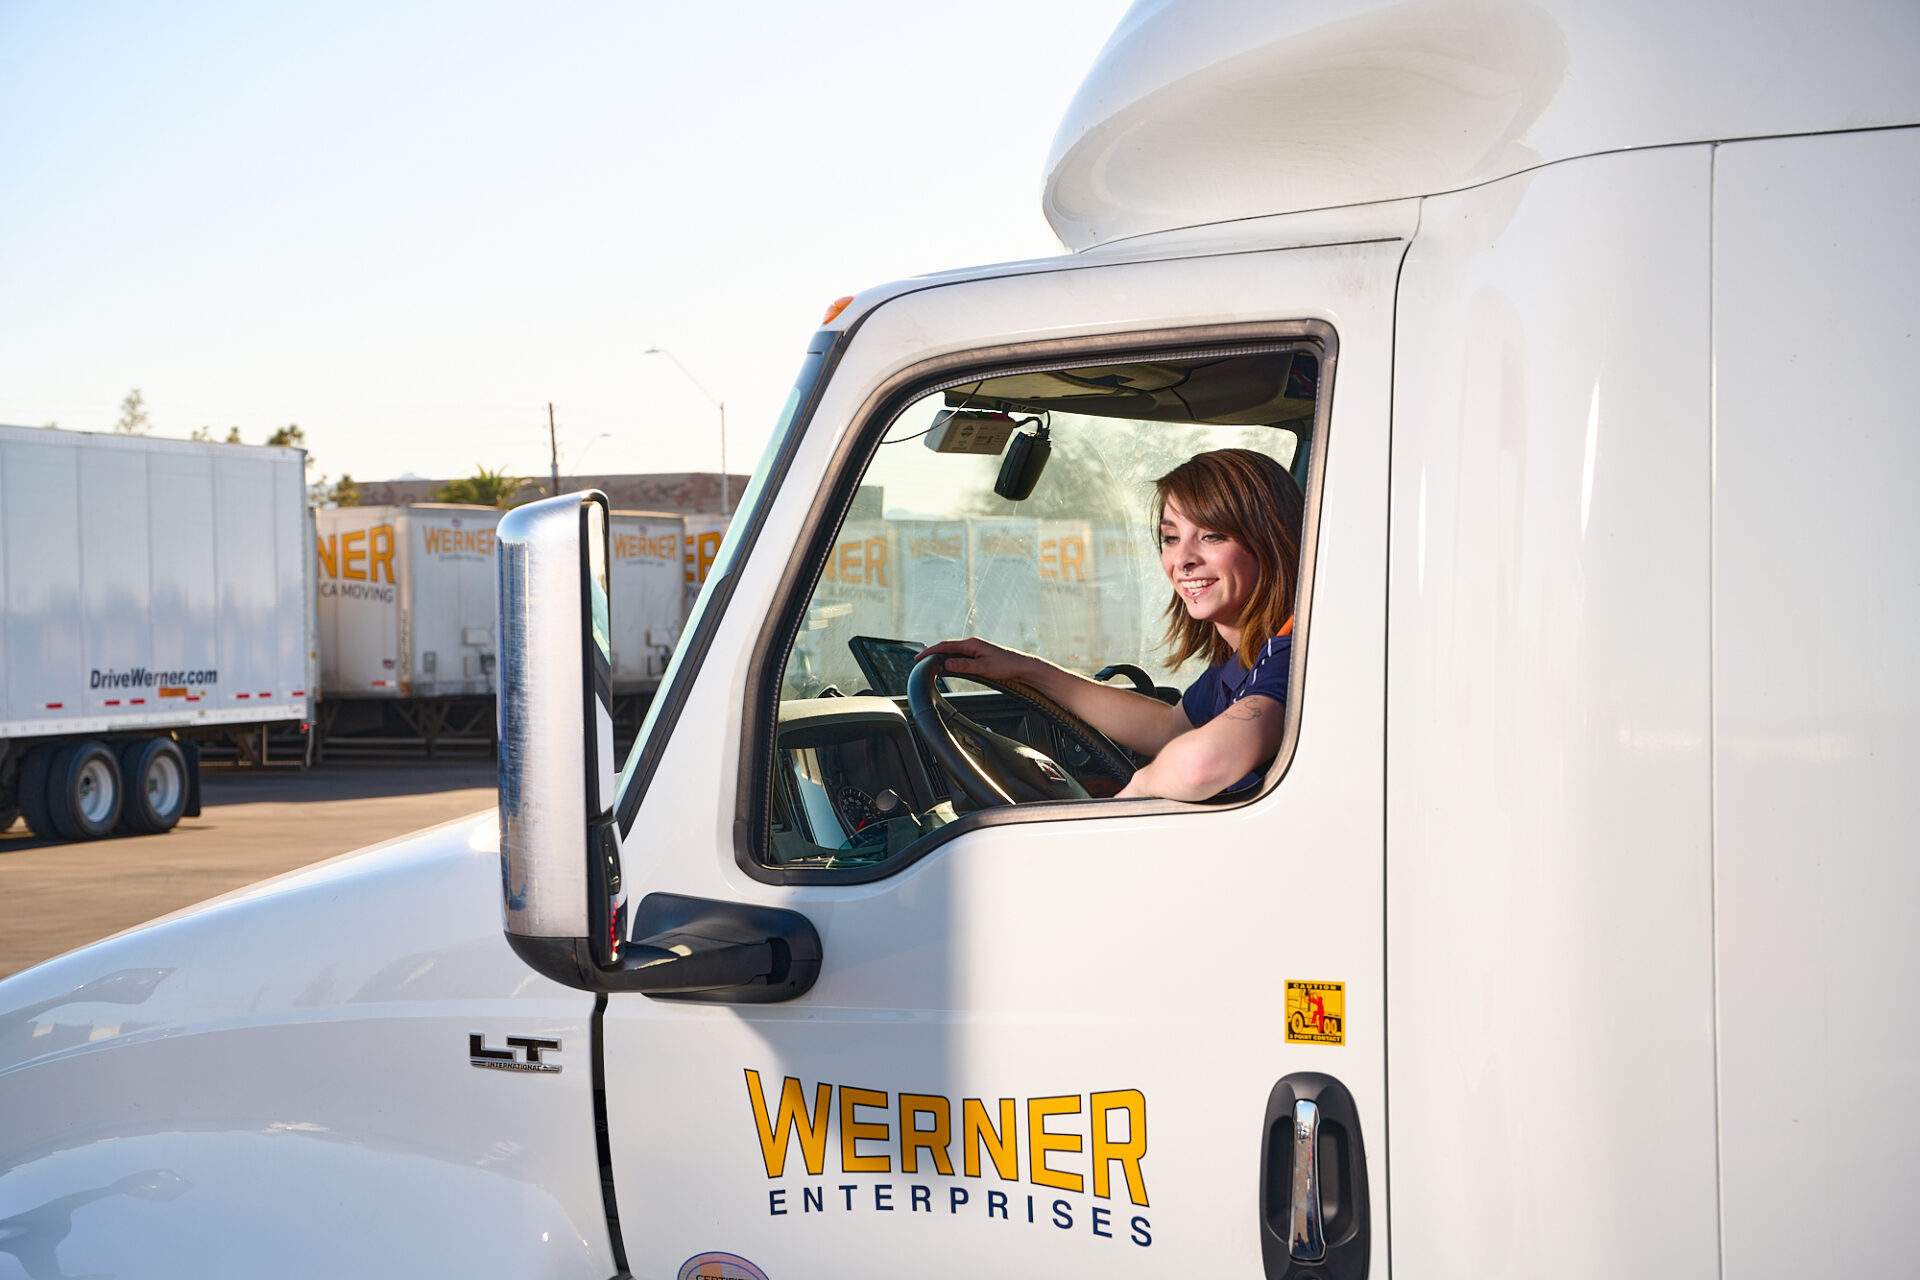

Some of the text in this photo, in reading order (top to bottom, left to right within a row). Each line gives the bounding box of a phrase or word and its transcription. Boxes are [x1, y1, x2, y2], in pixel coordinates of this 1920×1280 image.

[341, 584, 394, 602] MOVING
[90, 667, 217, 689] DriveWerner.com
[470, 1033, 561, 1064] LT
[744, 1069, 1149, 1207] WERNER
[769, 1184, 1152, 1247] ENTERPRISES
